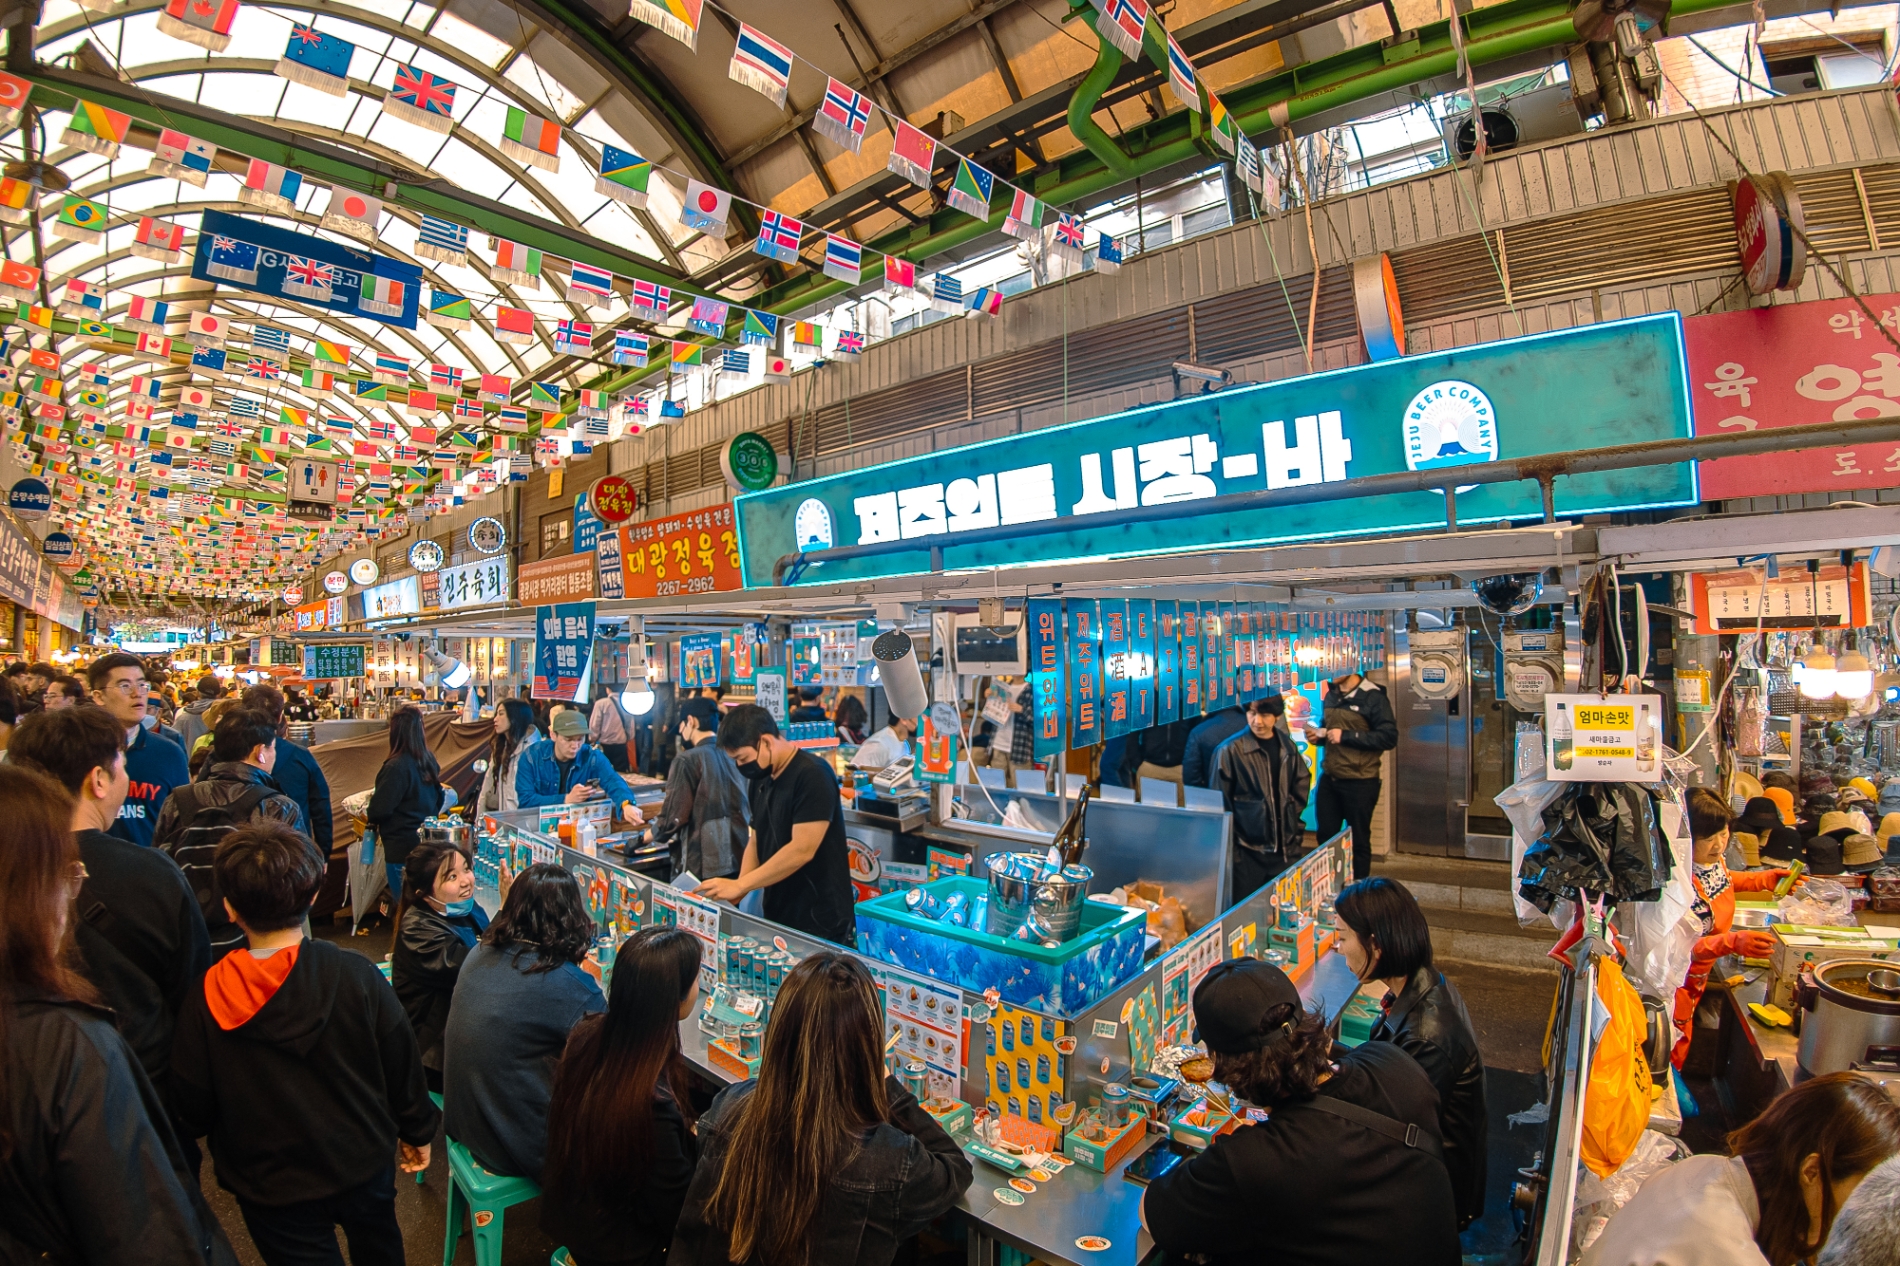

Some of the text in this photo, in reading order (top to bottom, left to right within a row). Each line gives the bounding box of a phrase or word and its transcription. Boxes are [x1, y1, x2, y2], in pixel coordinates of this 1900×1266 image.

[1409, 387, 1492, 458] JEJU BEER COMPANY
[854, 410, 1353, 546] 제주위트 시장-바
[603, 484, 629, 498] 대광
[627, 530, 740, 579] 대광정육점
[444, 564, 501, 603] 진주육회
[569, 570, 593, 593] 협동조합
[656, 576, 715, 596] 2267-2962
[543, 616, 588, 640] 외부 음식
[321, 647, 360, 658] 수정분식
[556, 645, 577, 668] 환영
[1039, 613, 1058, 739] 위트있네
[1076, 613, 1094, 730] 제주위트
[1580, 711, 1630, 725] 엄마손맛
[1589, 736, 1621, 744] 새마을금고
[129, 781, 162, 801] MY
[114, 805, 145, 819] ANS
